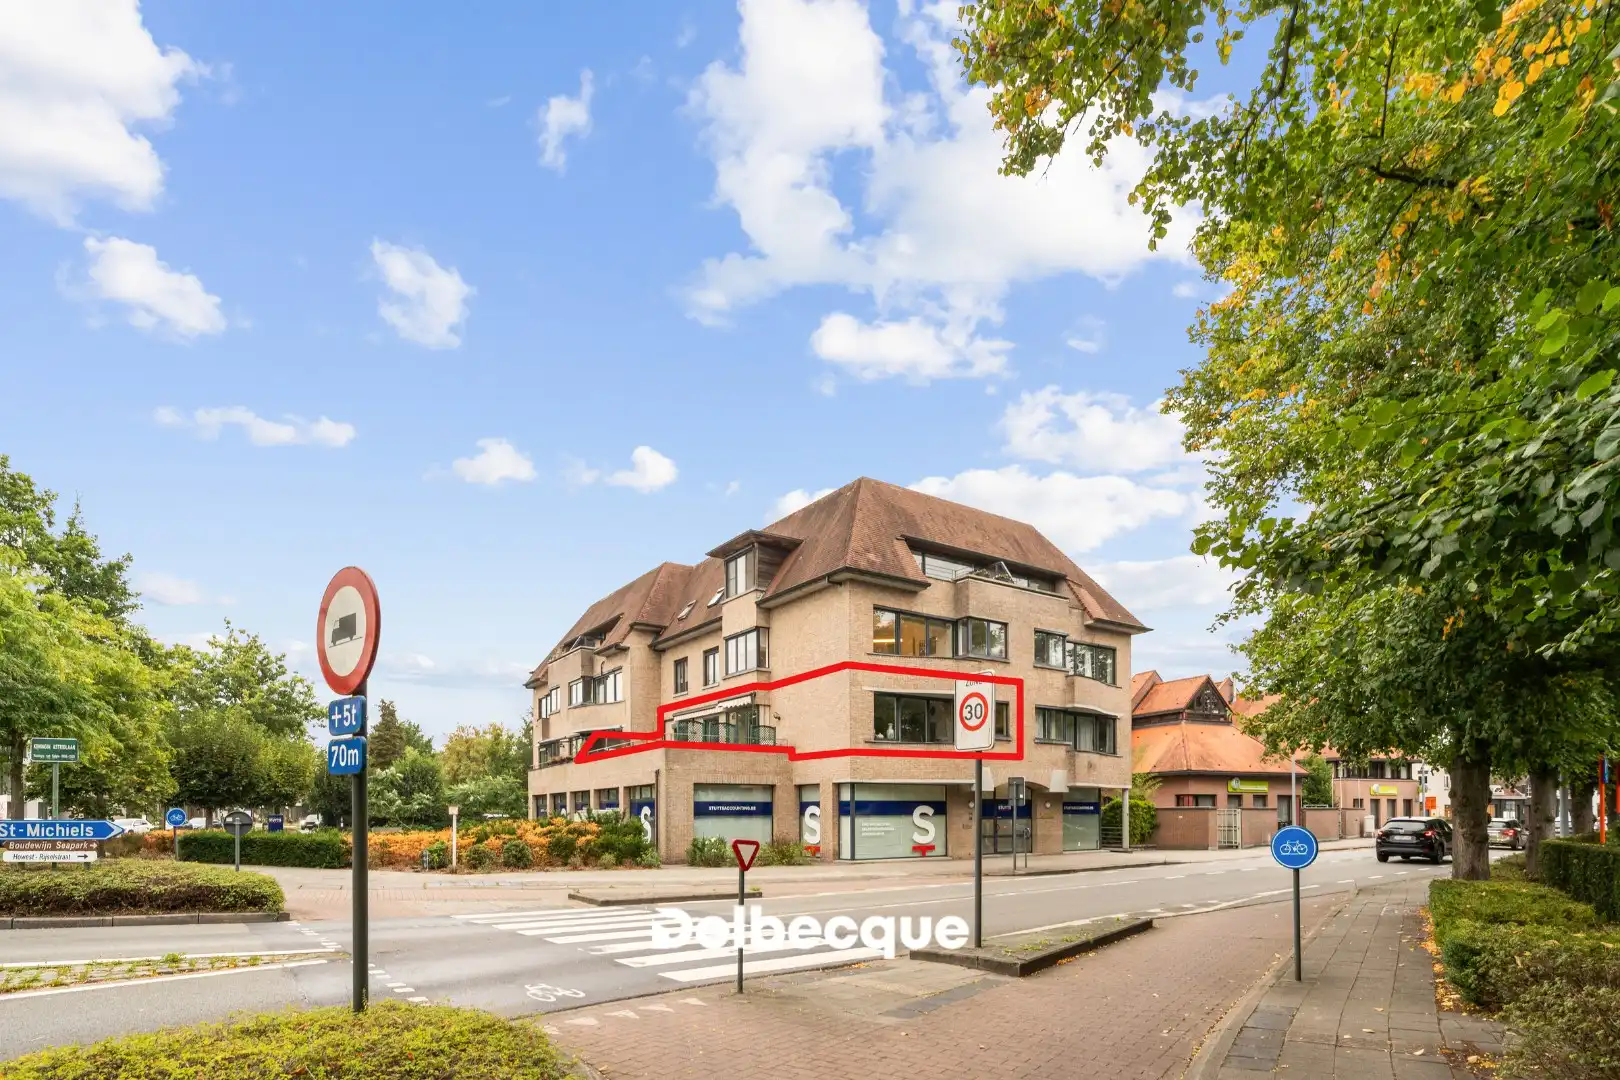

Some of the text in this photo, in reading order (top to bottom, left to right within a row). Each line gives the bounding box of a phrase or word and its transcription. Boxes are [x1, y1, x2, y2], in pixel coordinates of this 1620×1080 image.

[331, 704, 356, 728] +5t
[964, 703, 983, 721] 30
[331, 744, 359, 768] 70m
[804, 805, 820, 844] S
[912, 805, 936, 844] S
[9, 841, 88, 851] Boudewijn Seapark
